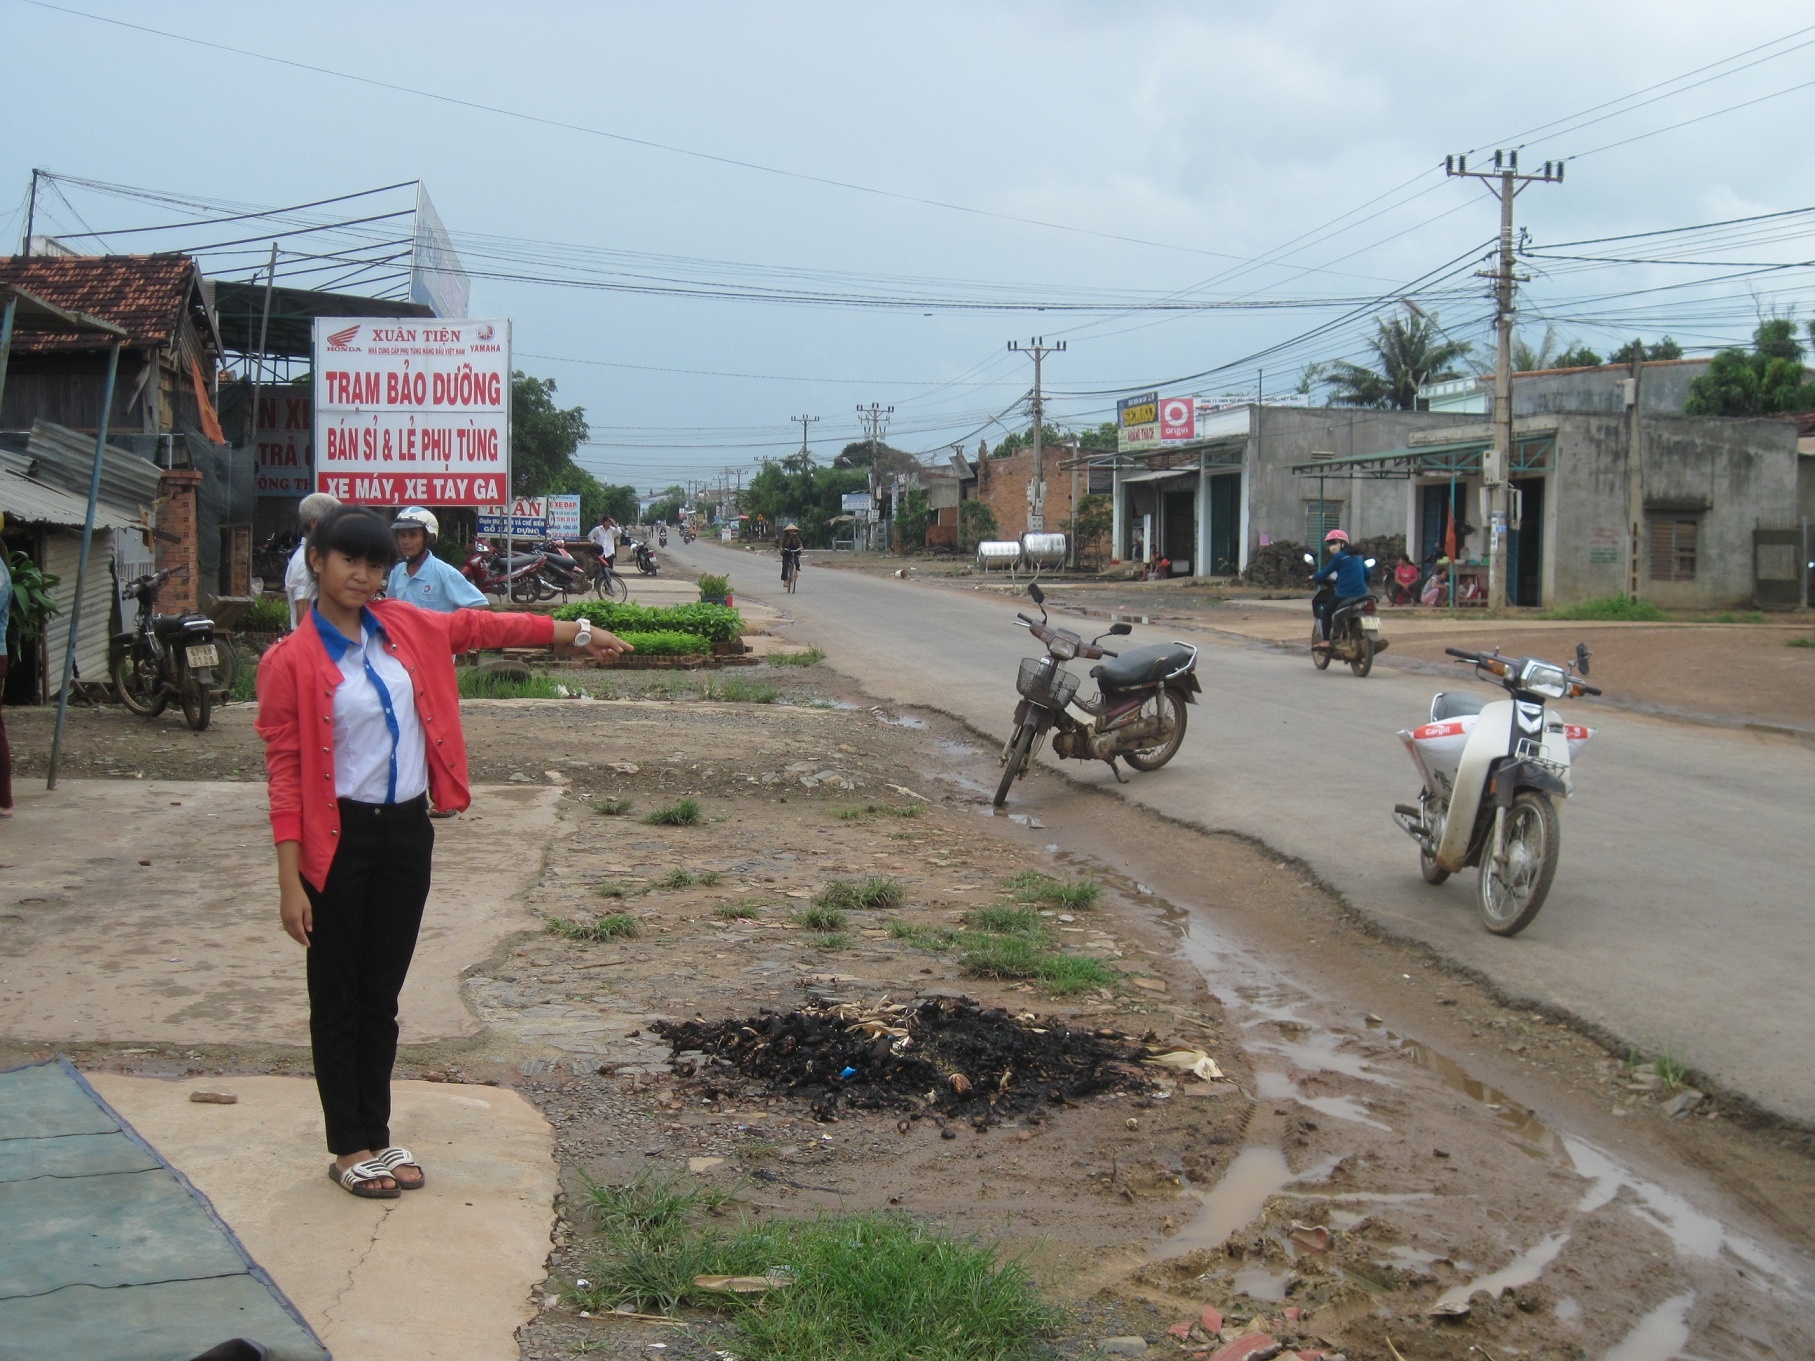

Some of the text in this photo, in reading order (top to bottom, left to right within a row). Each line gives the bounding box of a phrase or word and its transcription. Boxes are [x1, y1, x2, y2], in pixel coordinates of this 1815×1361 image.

[372, 327, 417, 342] XUÂN
[470, 344, 501, 353] YAMAHA
[325, 359, 501, 412] TRẠM BẢO DƯỠNG
[1165, 427, 1189, 436] origin
[258, 435, 298, 466] TRẢ
[327, 418, 358, 461] BÁN
[363, 415, 378, 461] SỈ
[382, 428, 393, 461] &
[398, 415, 417, 460] LẺ
[421, 428, 452, 471] PHỤ
[456, 418, 498, 462] TÙNG
[327, 478, 350, 499] XE
[404, 478, 427, 500] XE
[433, 478, 468, 500] TAY
[473, 478, 499, 500] GA
[1425, 726, 1451, 736] Cargill
